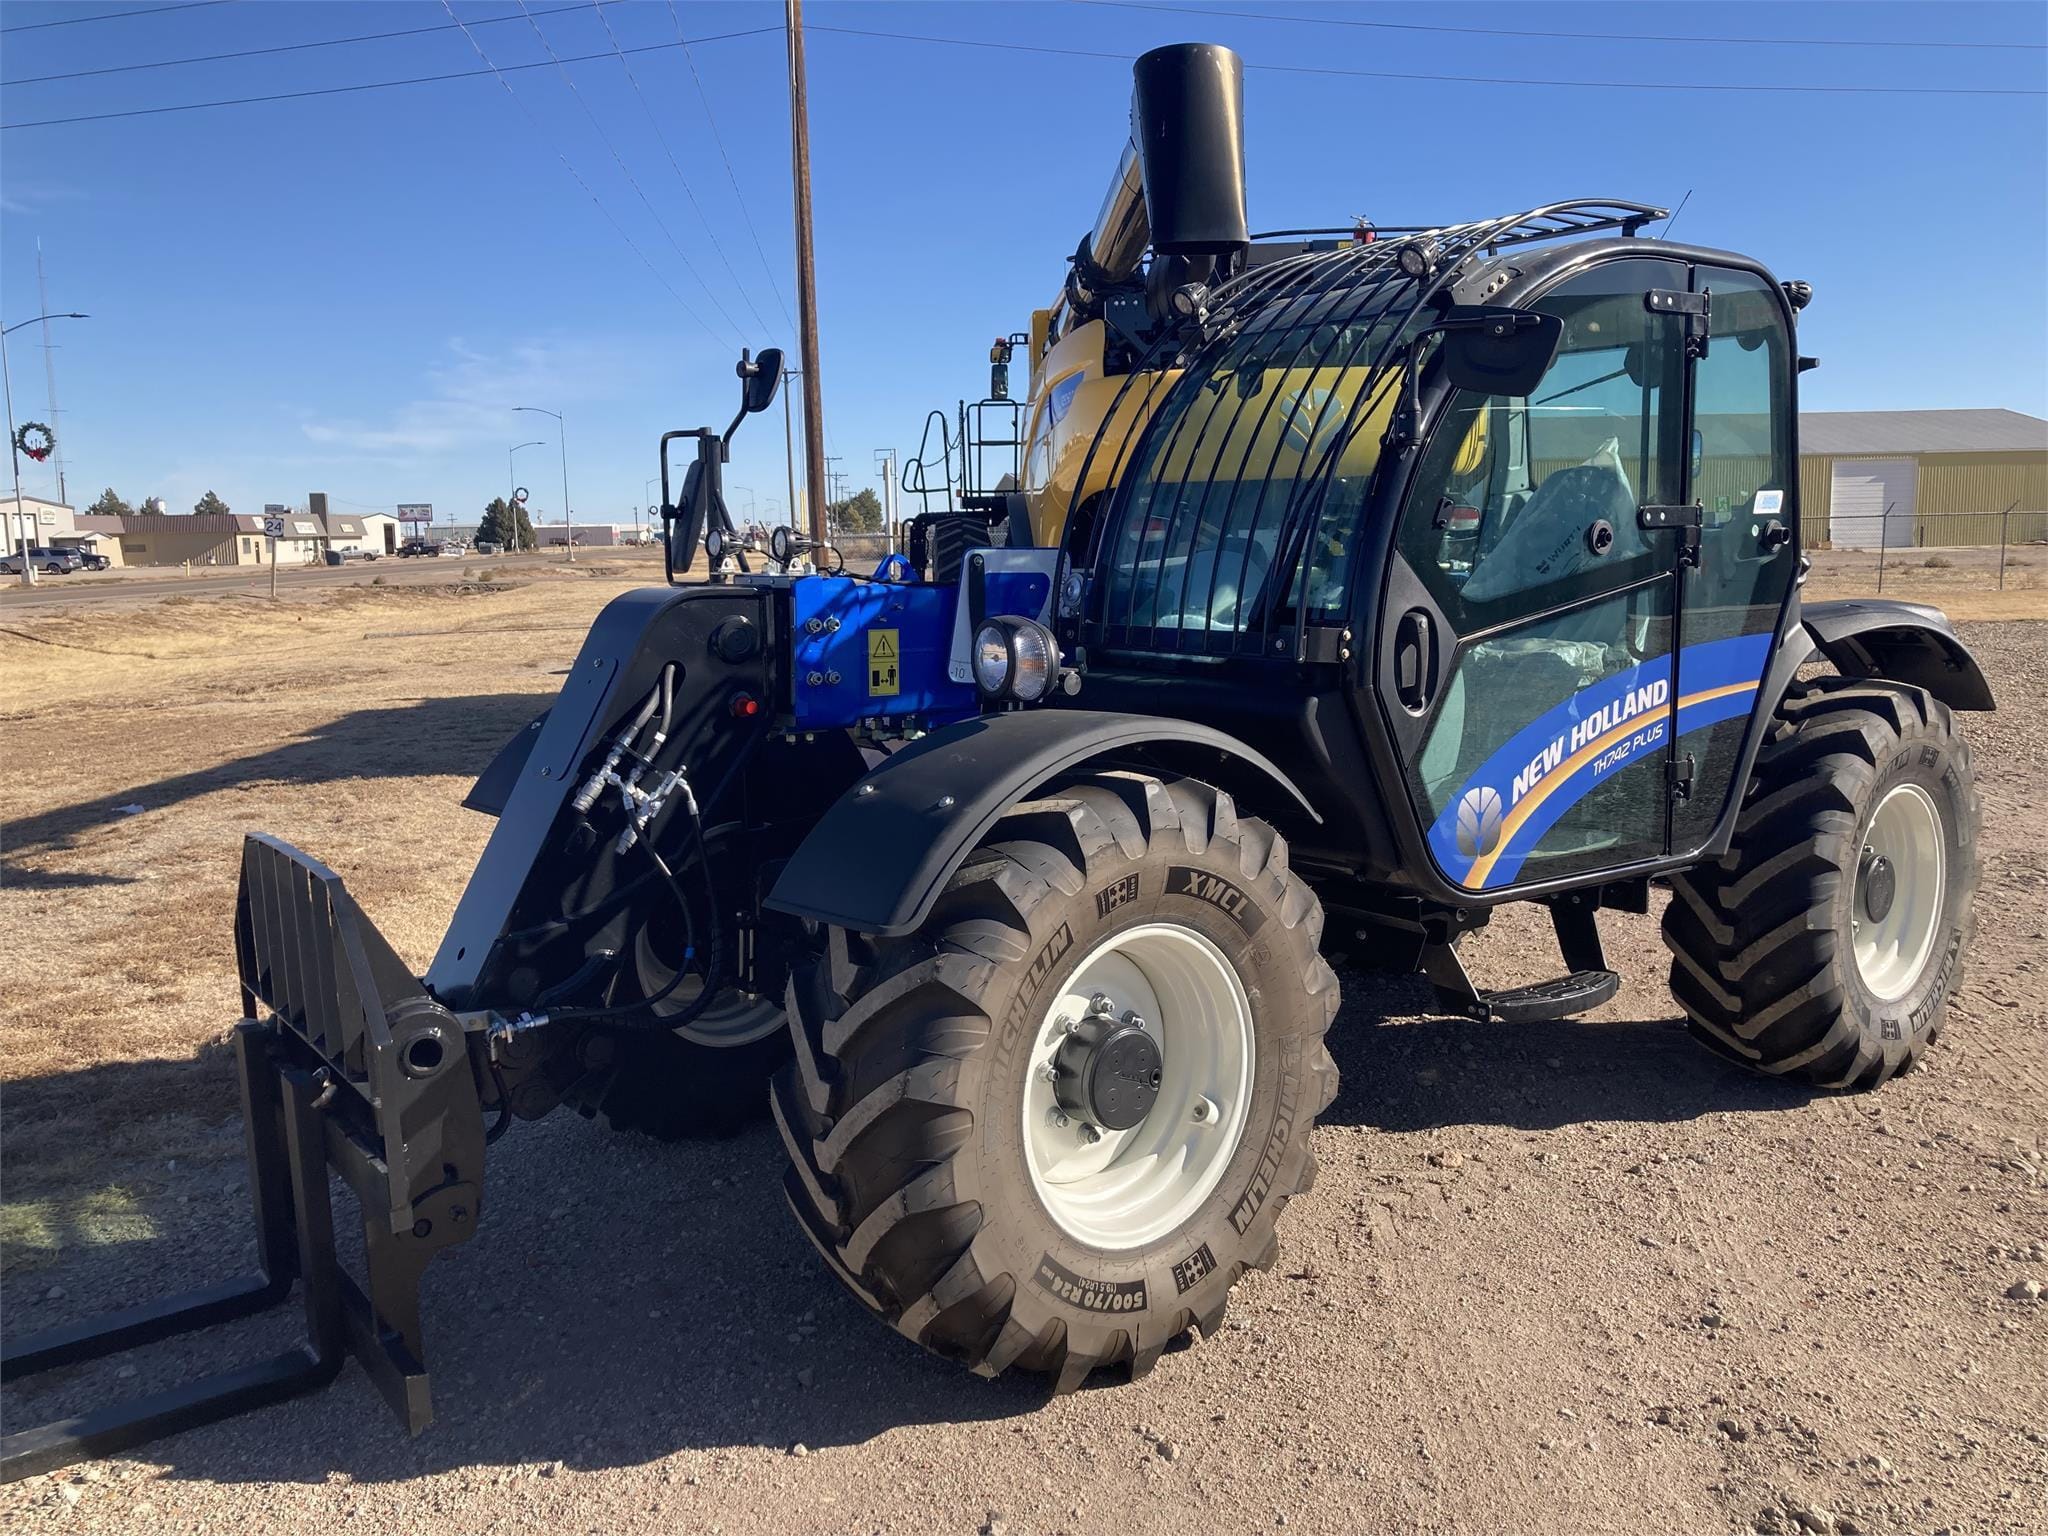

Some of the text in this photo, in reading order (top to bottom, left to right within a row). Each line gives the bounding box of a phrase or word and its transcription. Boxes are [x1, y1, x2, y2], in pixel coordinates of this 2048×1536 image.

[266, 521, 283, 533] 24
[1512, 679, 1668, 804] NEW HOLLAND
[1632, 723, 1663, 753] PLUS
[1182, 871, 1248, 920] XMCL
[988, 923, 1069, 1098] MICHELIN
[1912, 952, 1954, 1032] MICHELIN
[1234, 1072, 1299, 1235] MICHELIN
[1051, 1276, 1083, 1304] R24
[1084, 1290, 1143, 1310] 500/70
